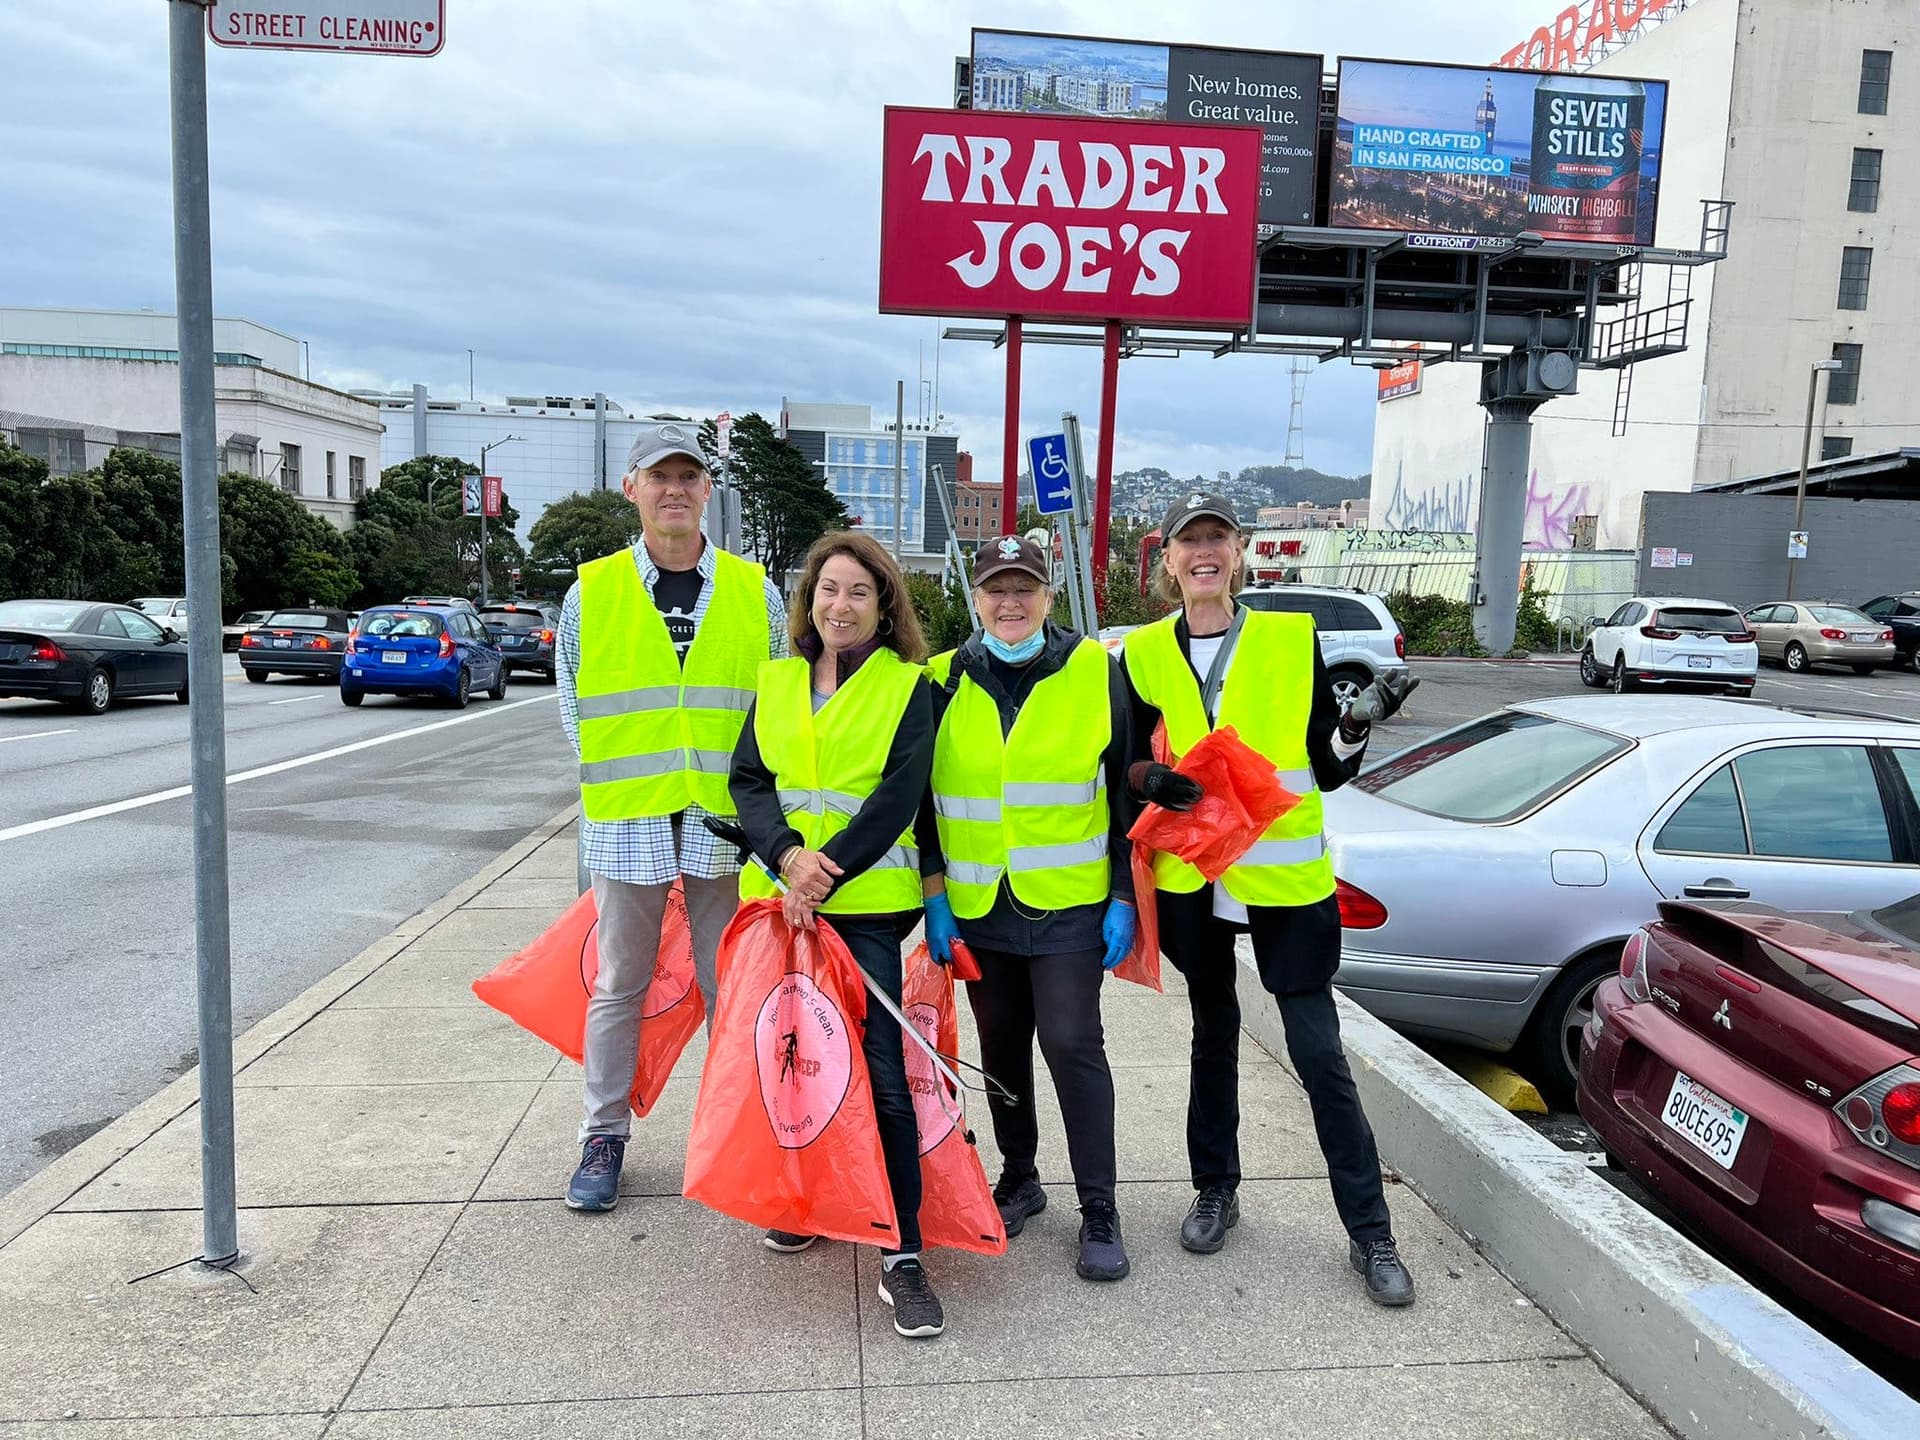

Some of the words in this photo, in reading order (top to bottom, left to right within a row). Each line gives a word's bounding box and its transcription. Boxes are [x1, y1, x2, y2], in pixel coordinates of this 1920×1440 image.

[229, 12, 306, 38] STREET
[319, 16, 422, 44] CLEANING
[1187, 74, 1231, 94] New
[1234, 77, 1302, 100] homes.
[1188, 100, 1240, 121] Great
[1244, 104, 1299, 125] value.
[1549, 98, 1628, 128] SEVEN
[1359, 127, 1405, 144] HAND
[1408, 131, 1481, 149] CRAFTED
[1547, 128, 1625, 158] STILLS
[911, 133, 1229, 215] TRADER
[1357, 149, 1374, 164] IN
[1377, 151, 1410, 167] SAN
[1412, 153, 1505, 173] FRANCISCO
[1528, 193, 1579, 216] WHISKEY
[1582, 197, 1634, 218] HIGHBALL
[1414, 235, 1470, 248] OUTFRONT
[946, 220, 1191, 296] JOE'S
[813, 1007, 834, 1040] clean.
[1688, 1082, 1732, 1120] California
[1669, 1092, 1736, 1156] 8UCE695
